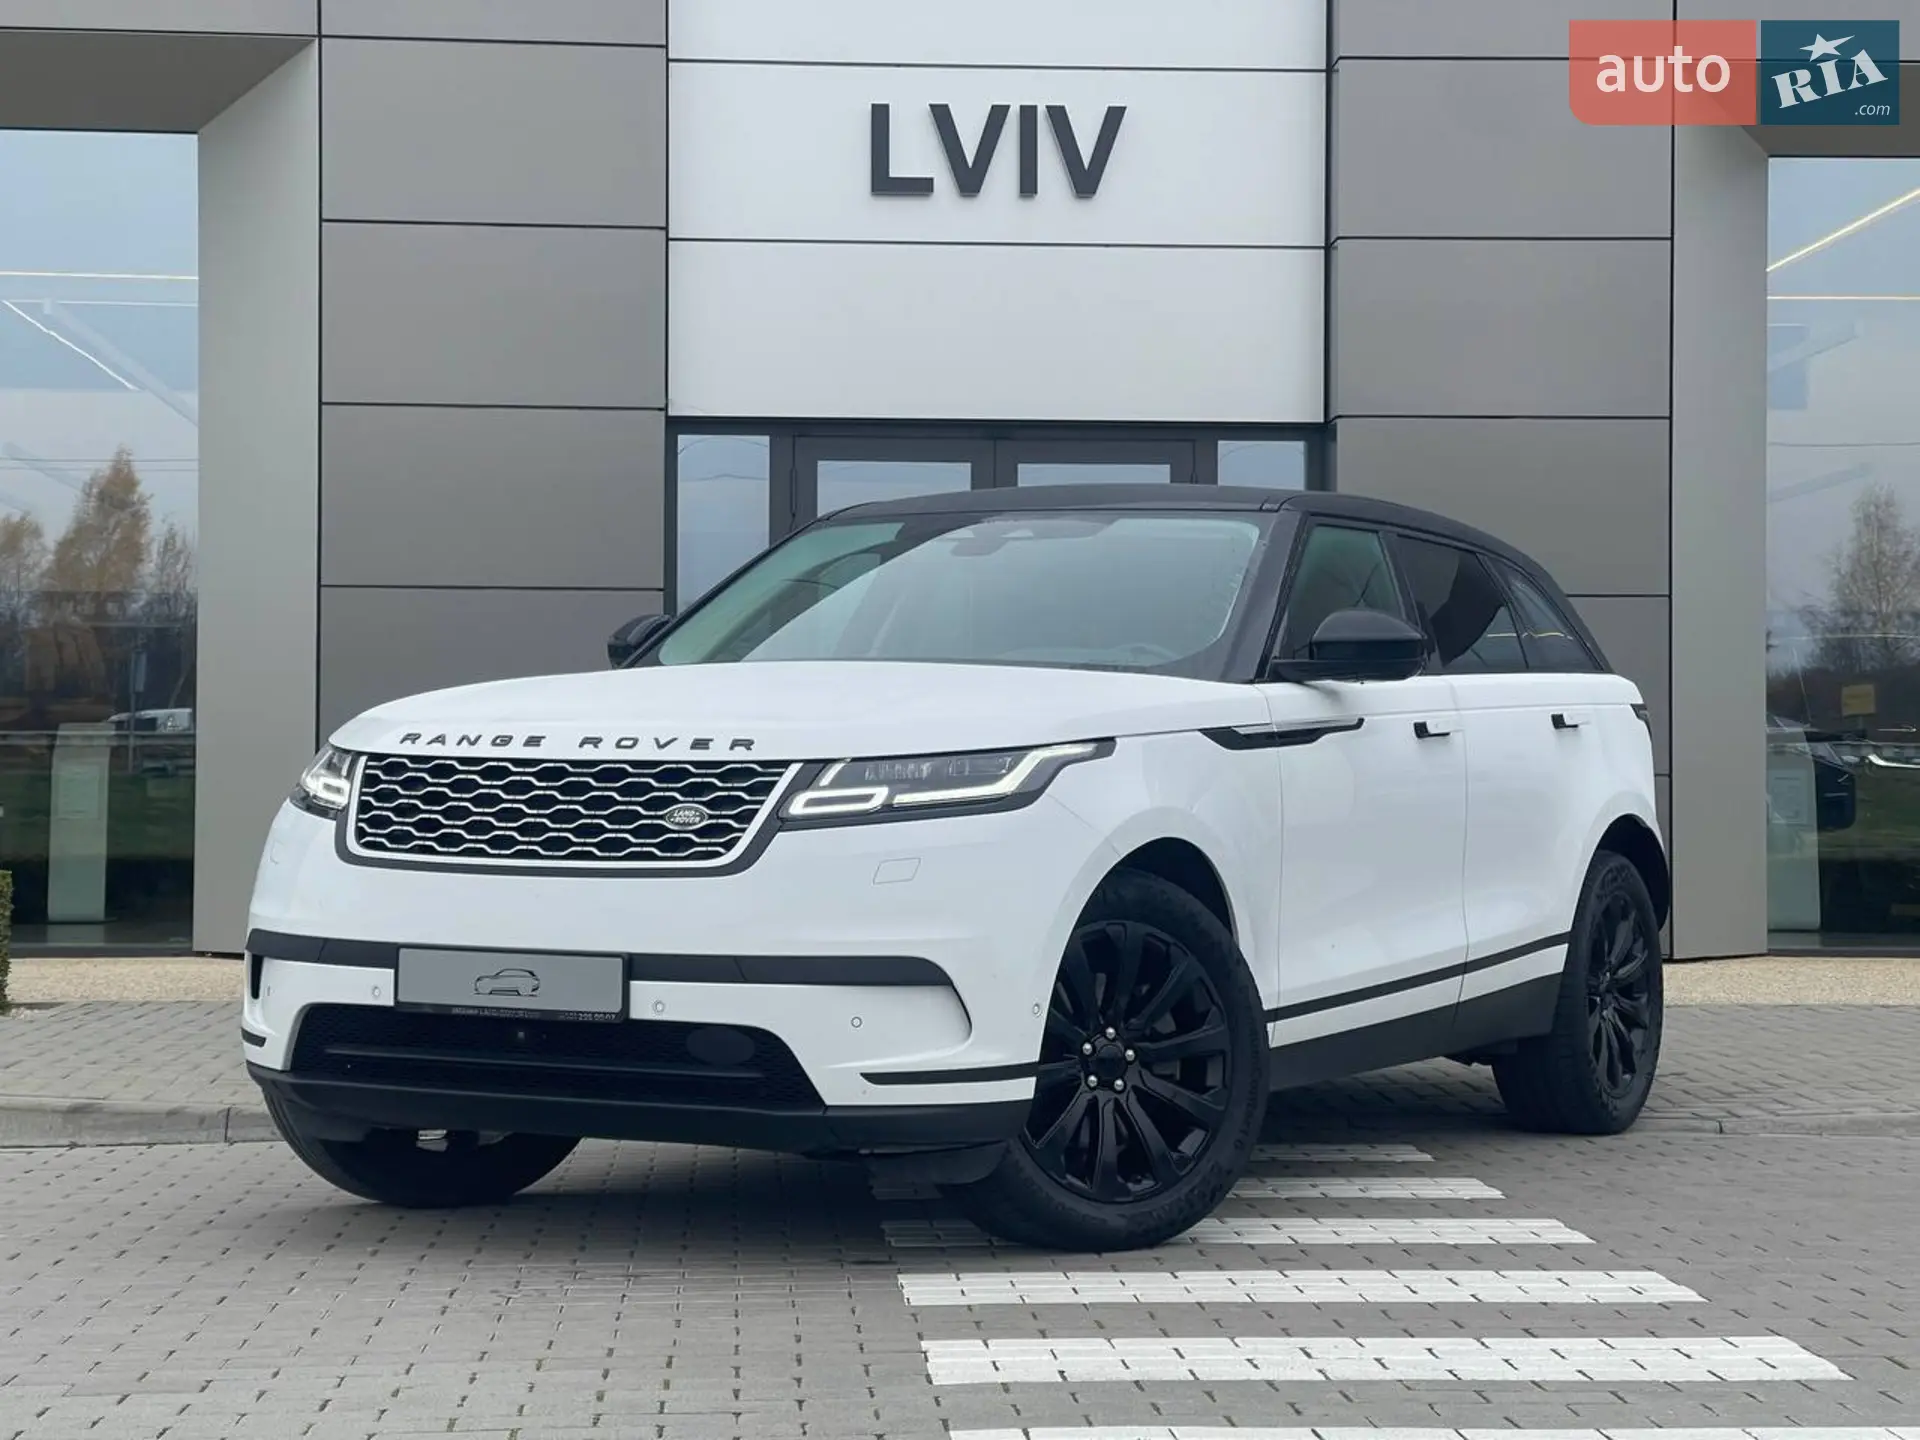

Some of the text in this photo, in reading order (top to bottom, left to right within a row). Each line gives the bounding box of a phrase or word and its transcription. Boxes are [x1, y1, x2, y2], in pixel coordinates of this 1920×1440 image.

[870, 103, 1128, 197] LVIV
[400, 732, 756, 751] RANGE ROVER
